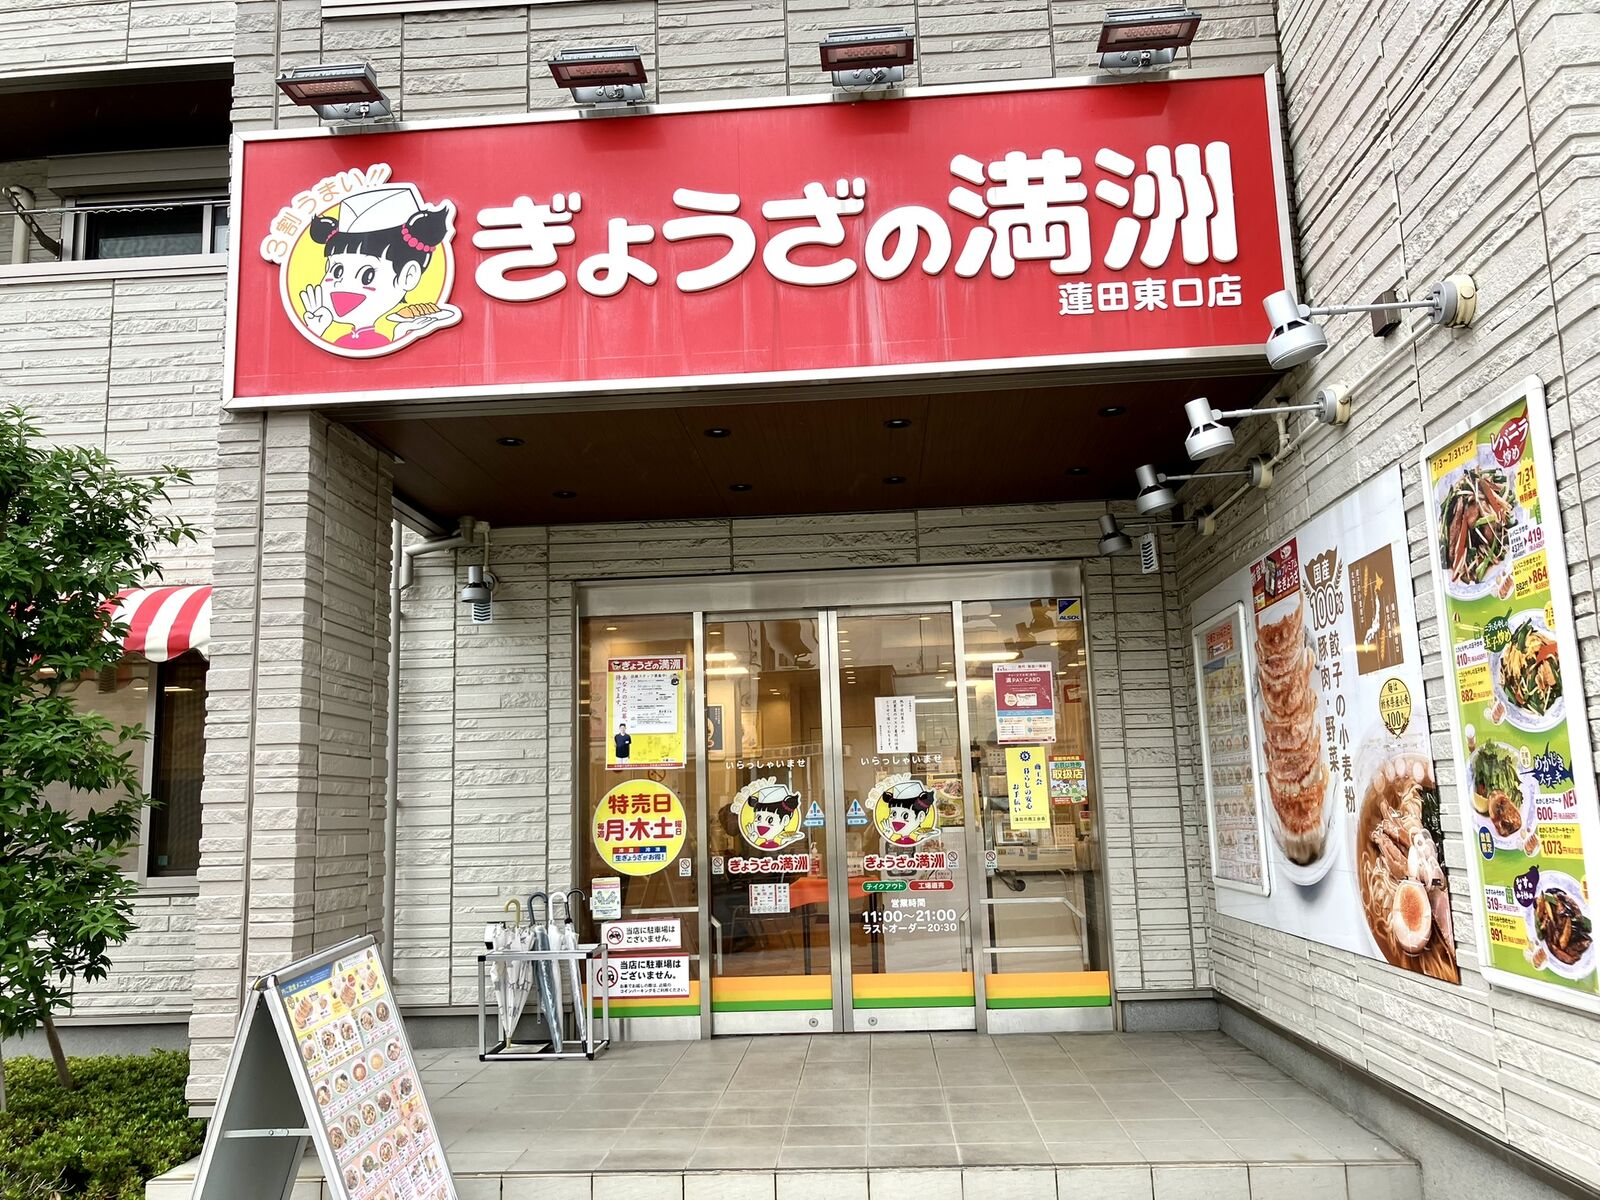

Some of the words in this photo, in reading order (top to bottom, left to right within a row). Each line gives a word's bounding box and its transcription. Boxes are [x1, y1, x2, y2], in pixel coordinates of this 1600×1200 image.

[472, 141, 1239, 302] ぎょうざの満洲
[1058, 274, 1243, 316] 蓮田東口店
[1490, 417, 1529, 451] レバニラ
[1313, 558, 1331, 586] 国産
[1309, 583, 1345, 632] 100%
[621, 658, 681, 671] ぎょうざの満洲
[1328, 630, 1356, 814] 餃子の小麦粉
[725, 758, 806, 770] いらっしゃいませ
[860, 754, 943, 766] いらっしゃいませ
[1052, 768, 1084, 780] 取扱店
[608, 793, 672, 815] 特売日
[604, 816, 674, 842] 月・木・土
[729, 855, 808, 872] ぎょうざの満洲
[864, 853, 945, 869] ぎょうざの満洲
[865, 882, 904, 890] テイクアウト
[890, 898, 926, 908] 営業時間
[626, 925, 676, 935] 当店に駐車場は
[862, 922, 957, 934] ラストオーダー20:30
[626, 934, 672, 944] ございません。
[620, 959, 682, 970] 当店に駐車場は
[620, 971, 676, 981] ございません。
